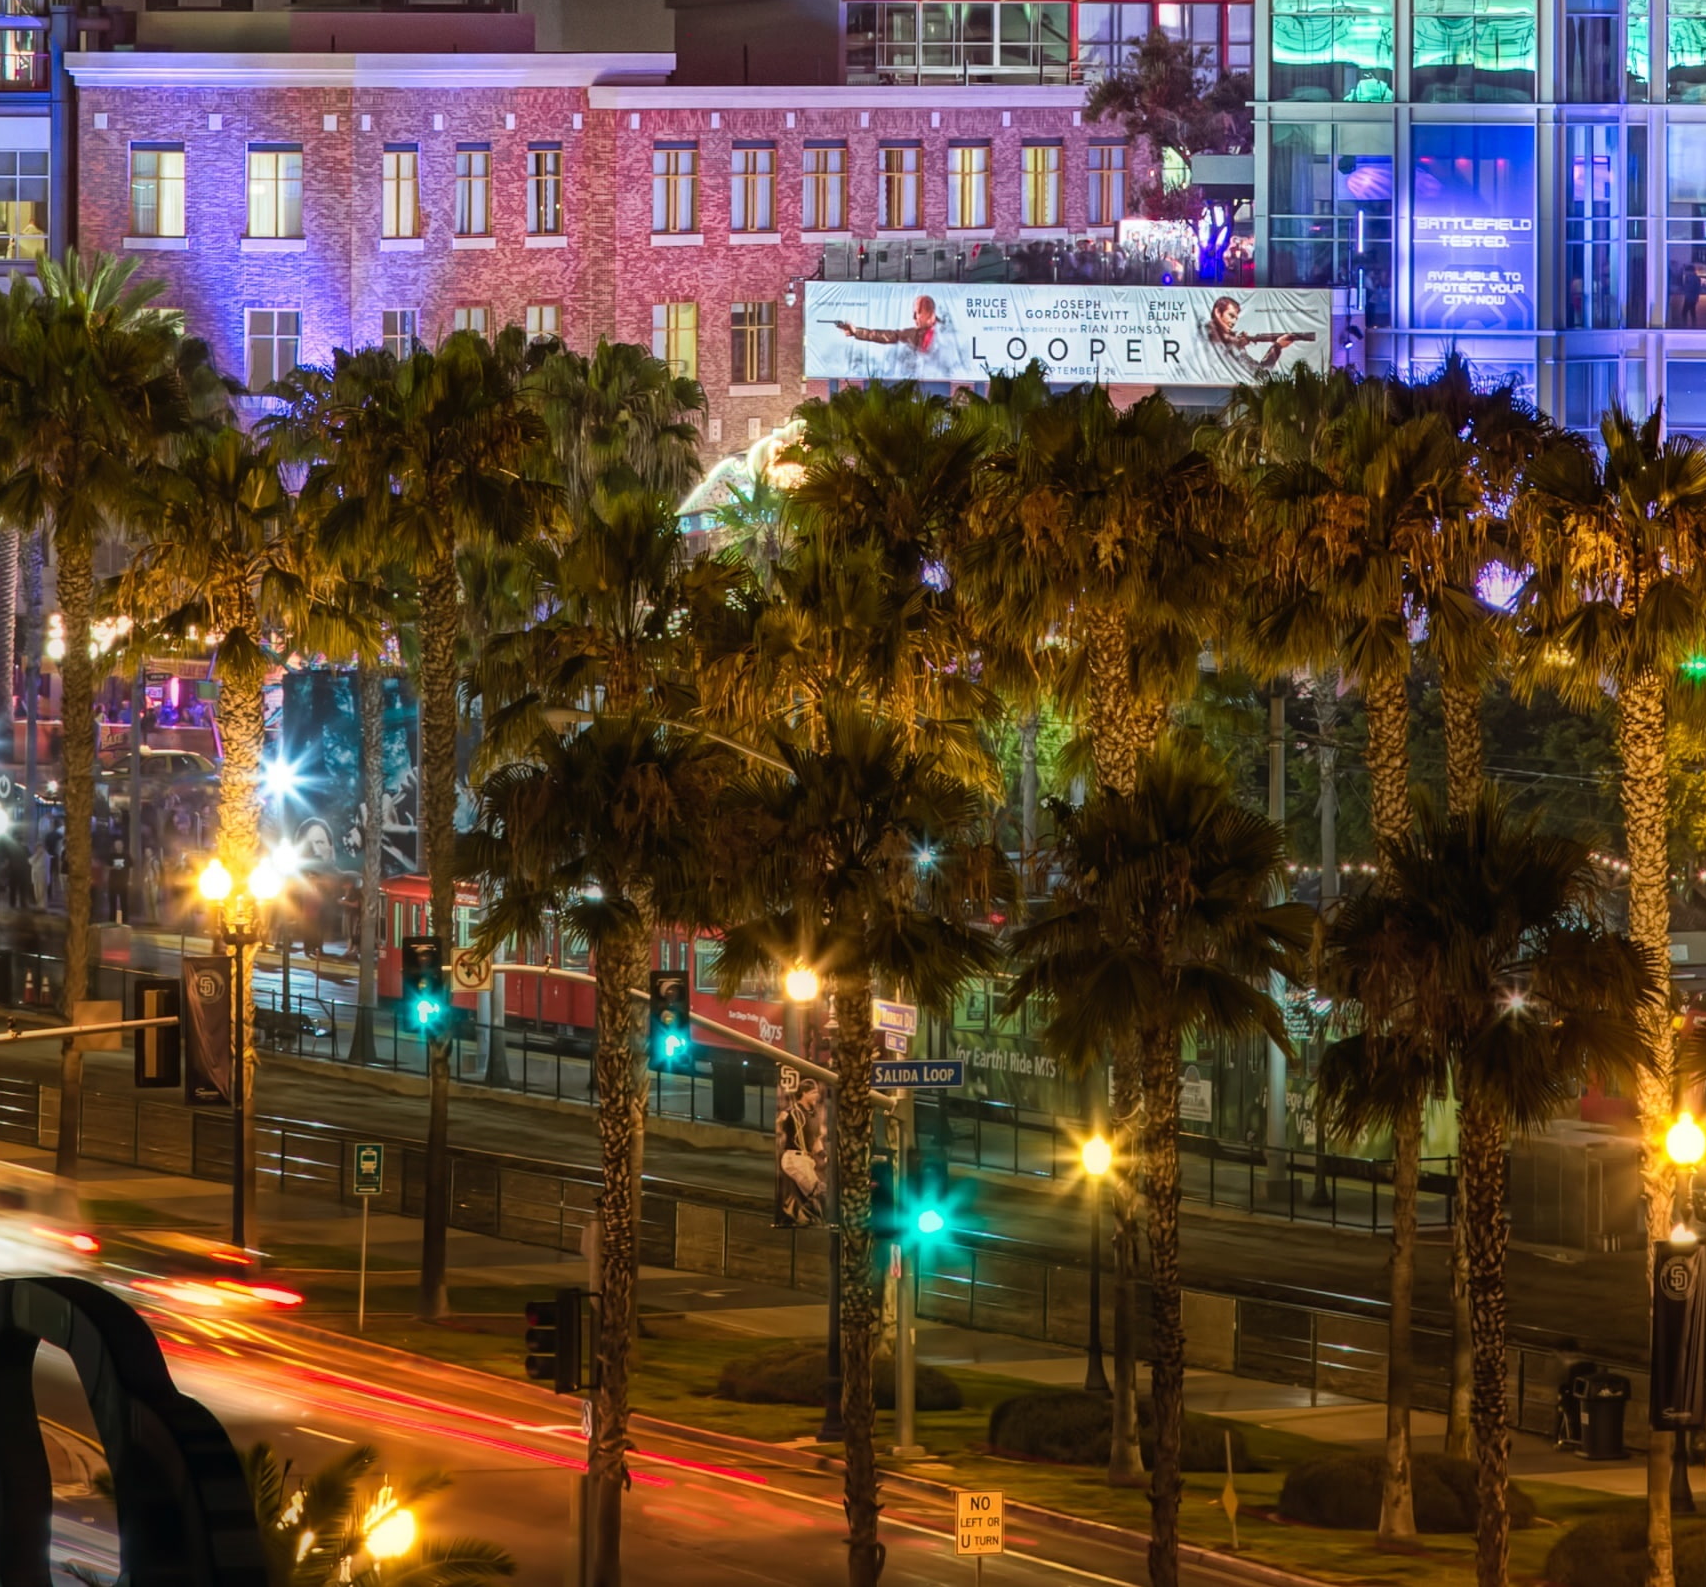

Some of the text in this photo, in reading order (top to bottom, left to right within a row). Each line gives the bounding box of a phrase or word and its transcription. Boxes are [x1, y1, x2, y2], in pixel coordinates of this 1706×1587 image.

[1416, 218, 1532, 231] BATTLEFIELD
[1427, 271, 1522, 282] AVAILABLE TO
[1424, 282, 1525, 294] PROTECT YOUR
[966, 298, 1007, 308] BRUCE
[1053, 299, 1101, 309] JOSEPH
[1443, 295, 1506, 305] CITY NOW
[1149, 301, 1185, 311] EMILY
[966, 308, 1007, 319] WILLIS
[1025, 309, 1129, 320] GORDON-LEVITT
[1148, 311, 1187, 322] BLUNT
[1080, 324, 1109, 334] RIAN
[1113, 325, 1171, 335] JOHNSON
[972, 336, 1181, 363] LOOPER
[973, 1046, 1008, 1070] Earth!
[1010, 1052, 1034, 1075] Ride
[875, 1065, 955, 1084] SALIDA LOOP
[970, 1496, 991, 1511] NO
[960, 1516, 1000, 1527] LEFT OR
[961, 1534, 999, 1548] U TURN
